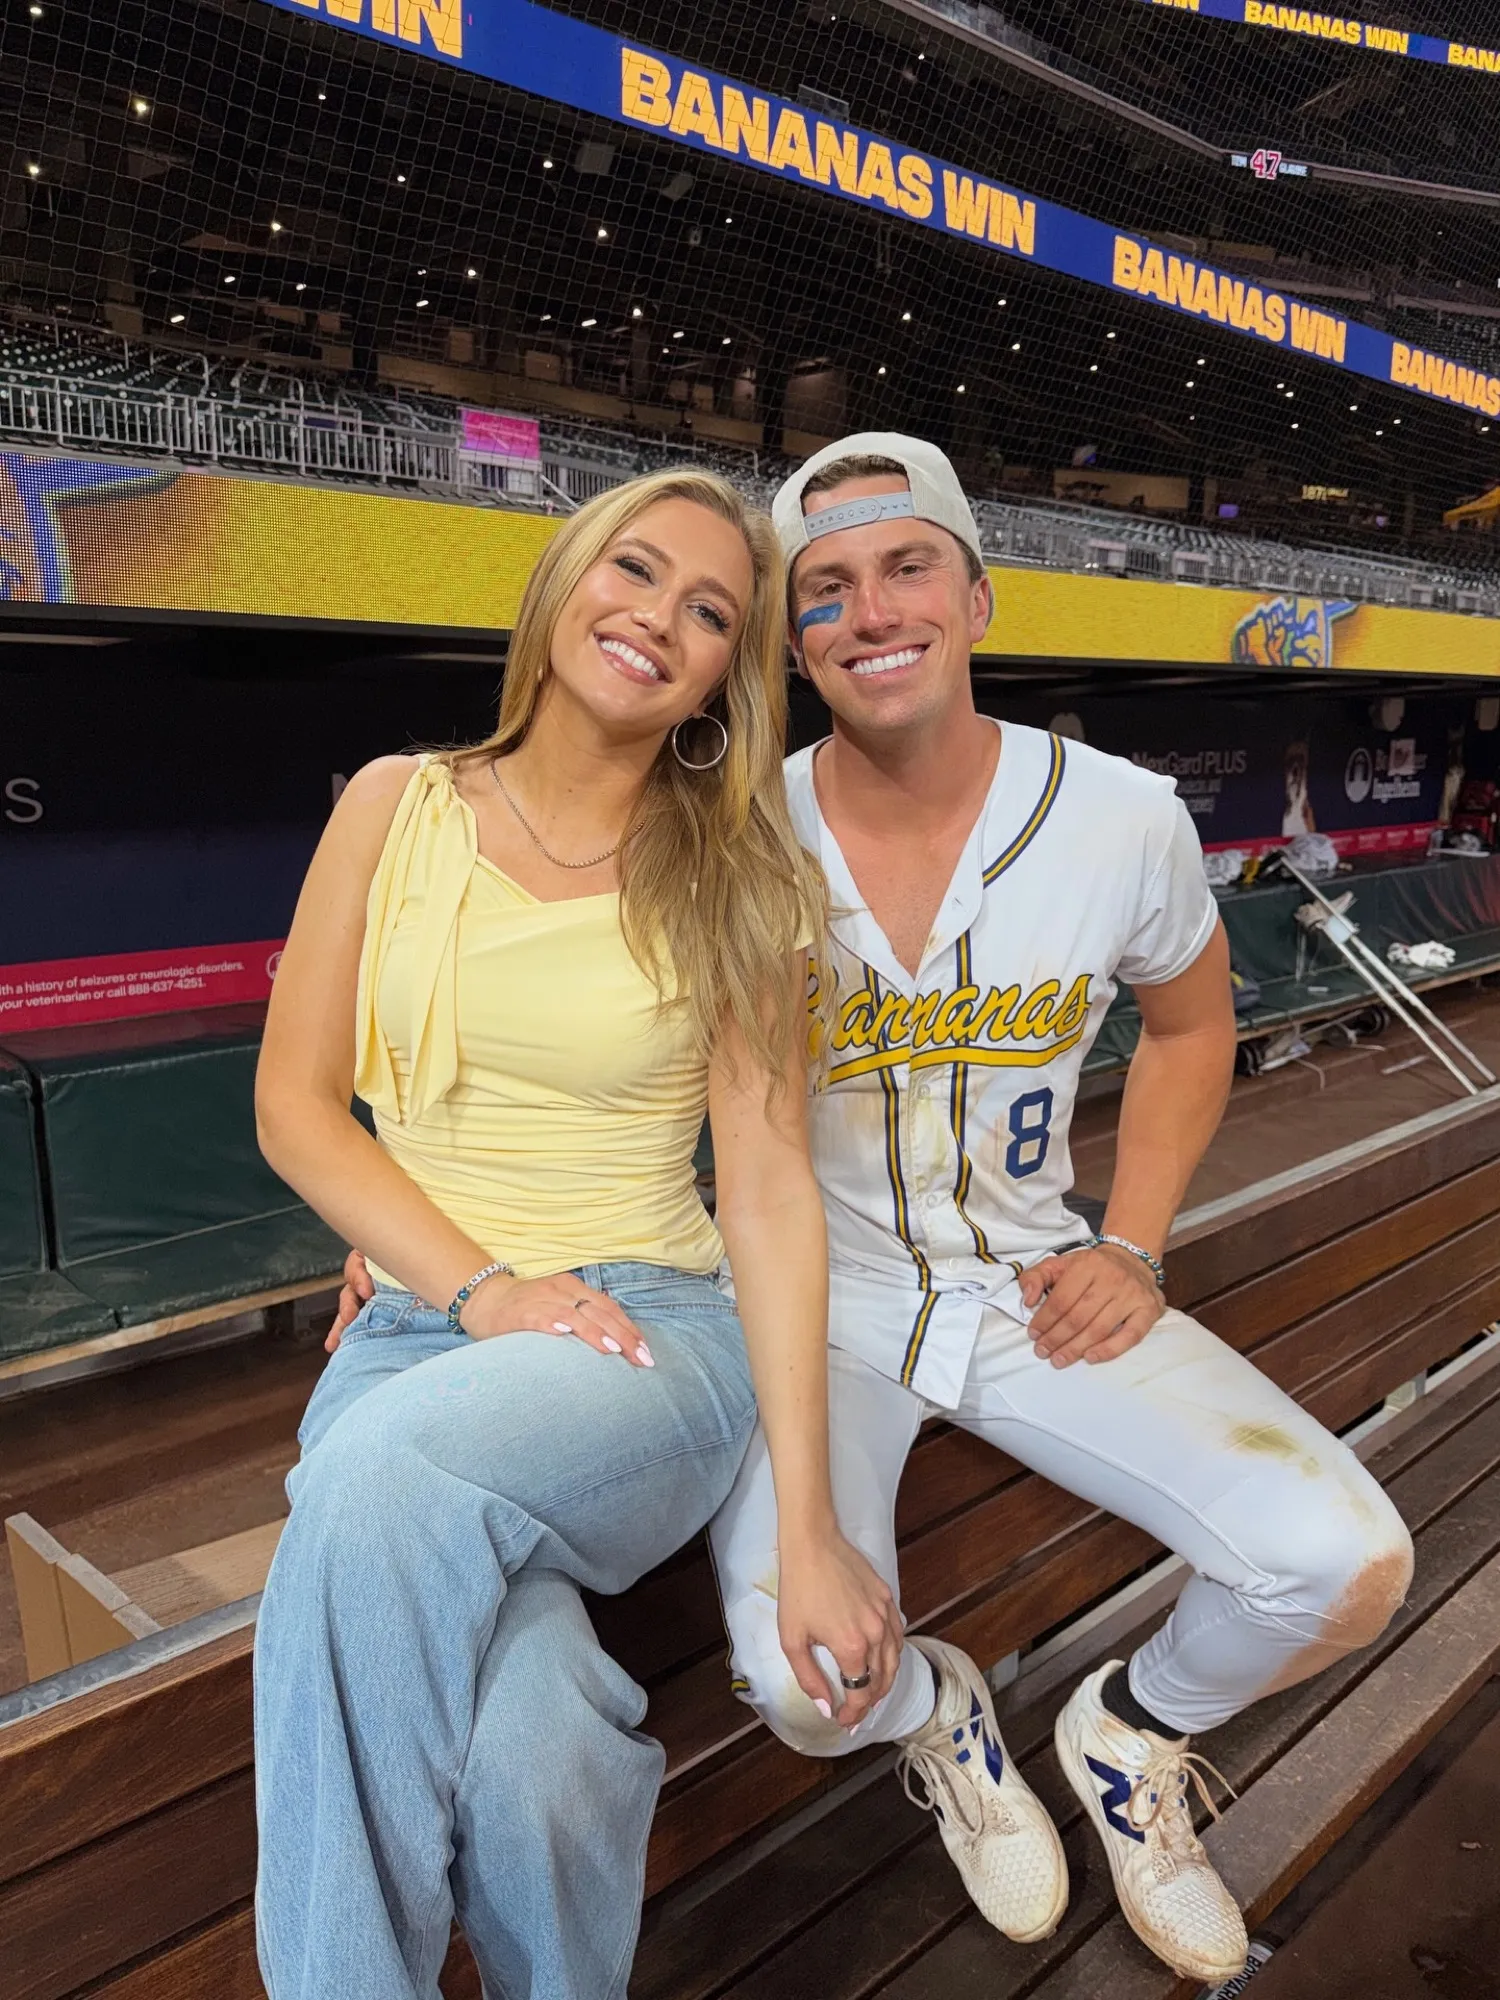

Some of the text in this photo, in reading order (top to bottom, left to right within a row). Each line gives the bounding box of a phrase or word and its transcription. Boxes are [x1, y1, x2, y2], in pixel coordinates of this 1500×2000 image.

[1244, 0, 1409, 55] BANANAS WIN
[621, 47, 1036, 256] BANANAS WIN
[1250, 148, 1282, 180] 47
[1112, 234, 1347, 364] BANANAS WIN
[1390, 341, 1500, 417] BANANAS
[0, 998, 24, 1012] your
[26, 990, 91, 1008] veterinarian
[93, 990, 105, 1000] or
[106, 985, 126, 998] call
[16, 986, 23, 995] a
[25, 980, 64, 993] history
[66, 976, 78, 988] of
[80, 973, 125, 987] seizures
[126, 973, 138, 983] or
[140, 965, 195, 981] neurologic
[1005, 1086, 1054, 1180] 8
